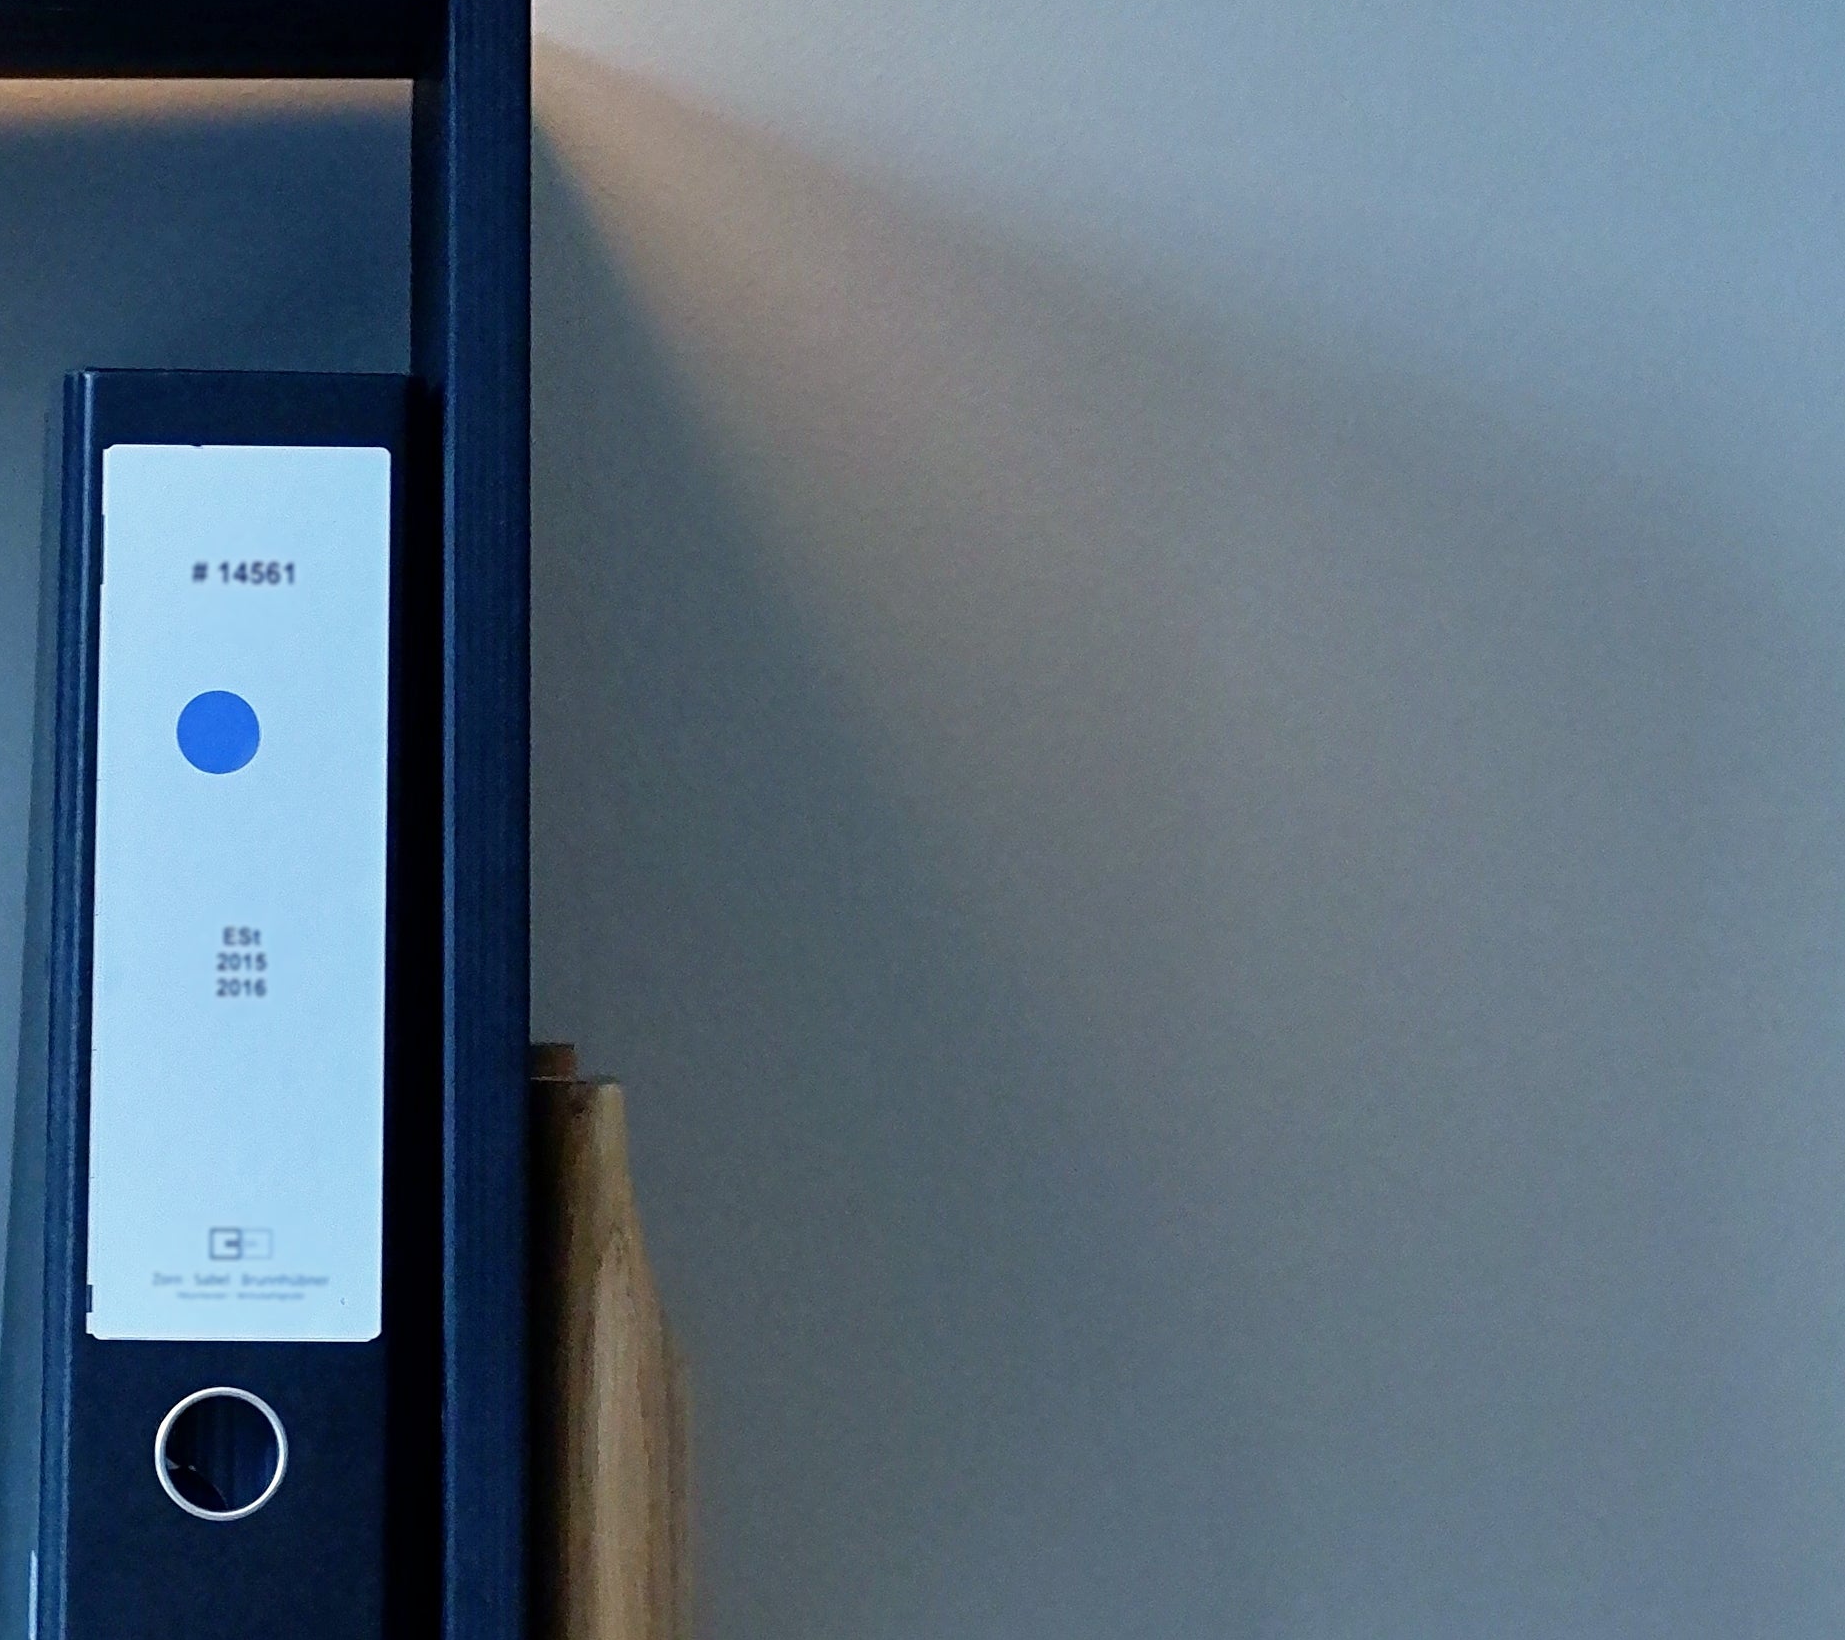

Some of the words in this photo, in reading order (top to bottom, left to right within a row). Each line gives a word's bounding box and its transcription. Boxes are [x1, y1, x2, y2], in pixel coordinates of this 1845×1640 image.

[191, 561, 208, 583] #
[218, 561, 295, 584] 14561
[222, 927, 261, 947] ESt
[216, 952, 267, 972] 2015
[216, 978, 267, 997] 2016
